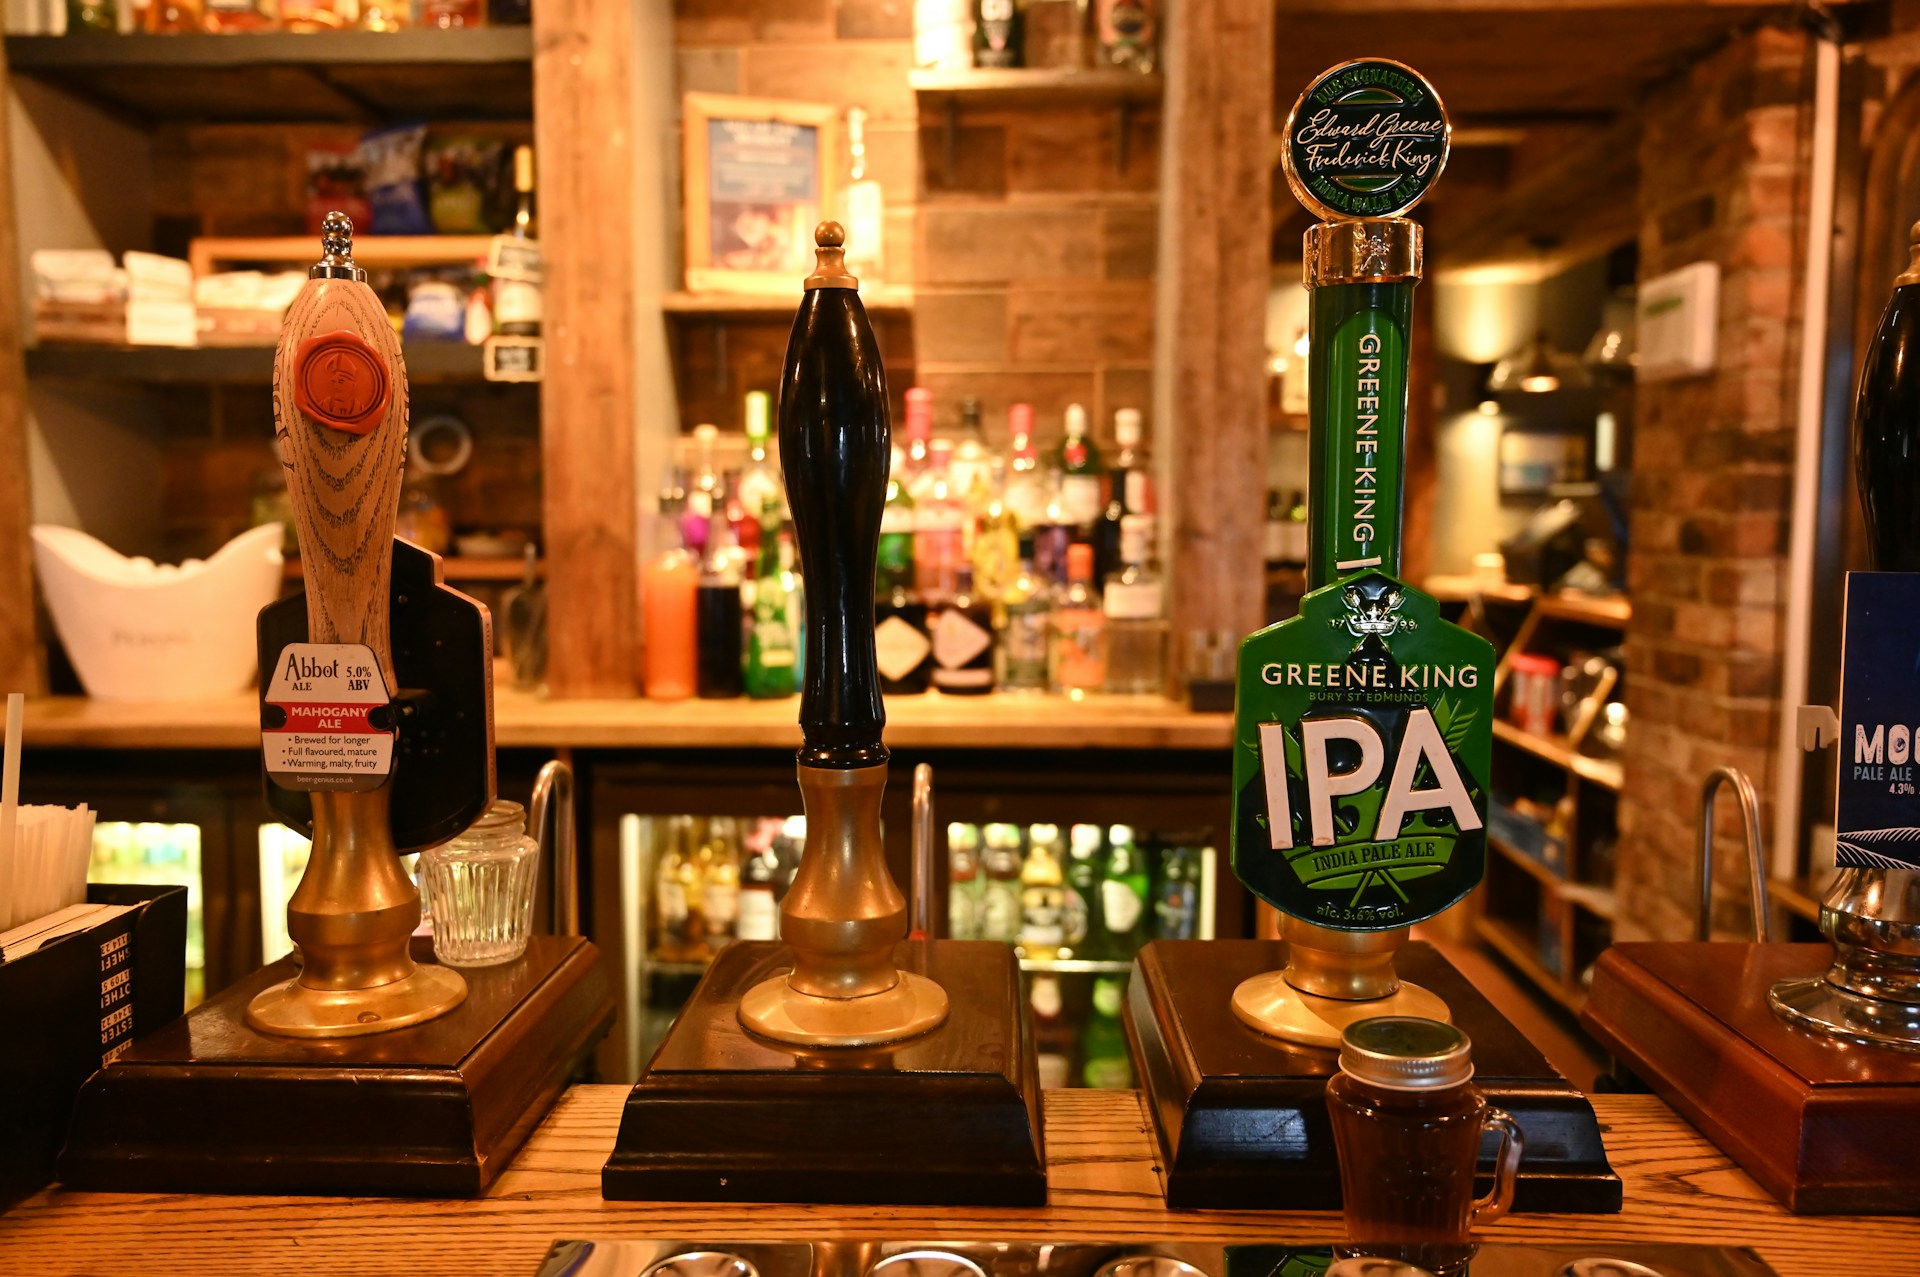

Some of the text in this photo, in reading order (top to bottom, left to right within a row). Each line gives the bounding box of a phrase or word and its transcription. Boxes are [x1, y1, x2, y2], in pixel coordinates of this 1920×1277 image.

[1314, 68, 1424, 104] OUR SIGNATURE
[1296, 108, 1444, 149] Edward Greene
[1305, 140, 1437, 176] Frederick King
[1310, 174, 1421, 212] INDIA PALE ALE
[1353, 333, 1381, 543] GREENE KING
[284, 653, 372, 682] Abbot 5.0%
[1261, 662, 1478, 689] GREENE KING
[292, 679, 370, 691] ALE ABV
[1309, 691, 1342, 702] BURY
[1366, 691, 1428, 703] EDMUNDS
[291, 706, 369, 718] MAHOGANY
[317, 719, 342, 729] ALE
[294, 735, 371, 746] Brewed for longer
[1854, 723, 1920, 765] MO
[288, 747, 378, 757] Full flavoured, mature
[287, 759, 378, 770] Warming, malty, fruity
[296, 775, 354, 785] beer-genius.co.uk
[1257, 706, 1484, 850] IPA
[1853, 766, 1912, 783] PALE ALE
[1889, 783, 1915, 795] 4.3%
[1312, 842, 1436, 873] INDIA PALE ALE
[1317, 905, 1405, 921] alc. 3.6% vol.
